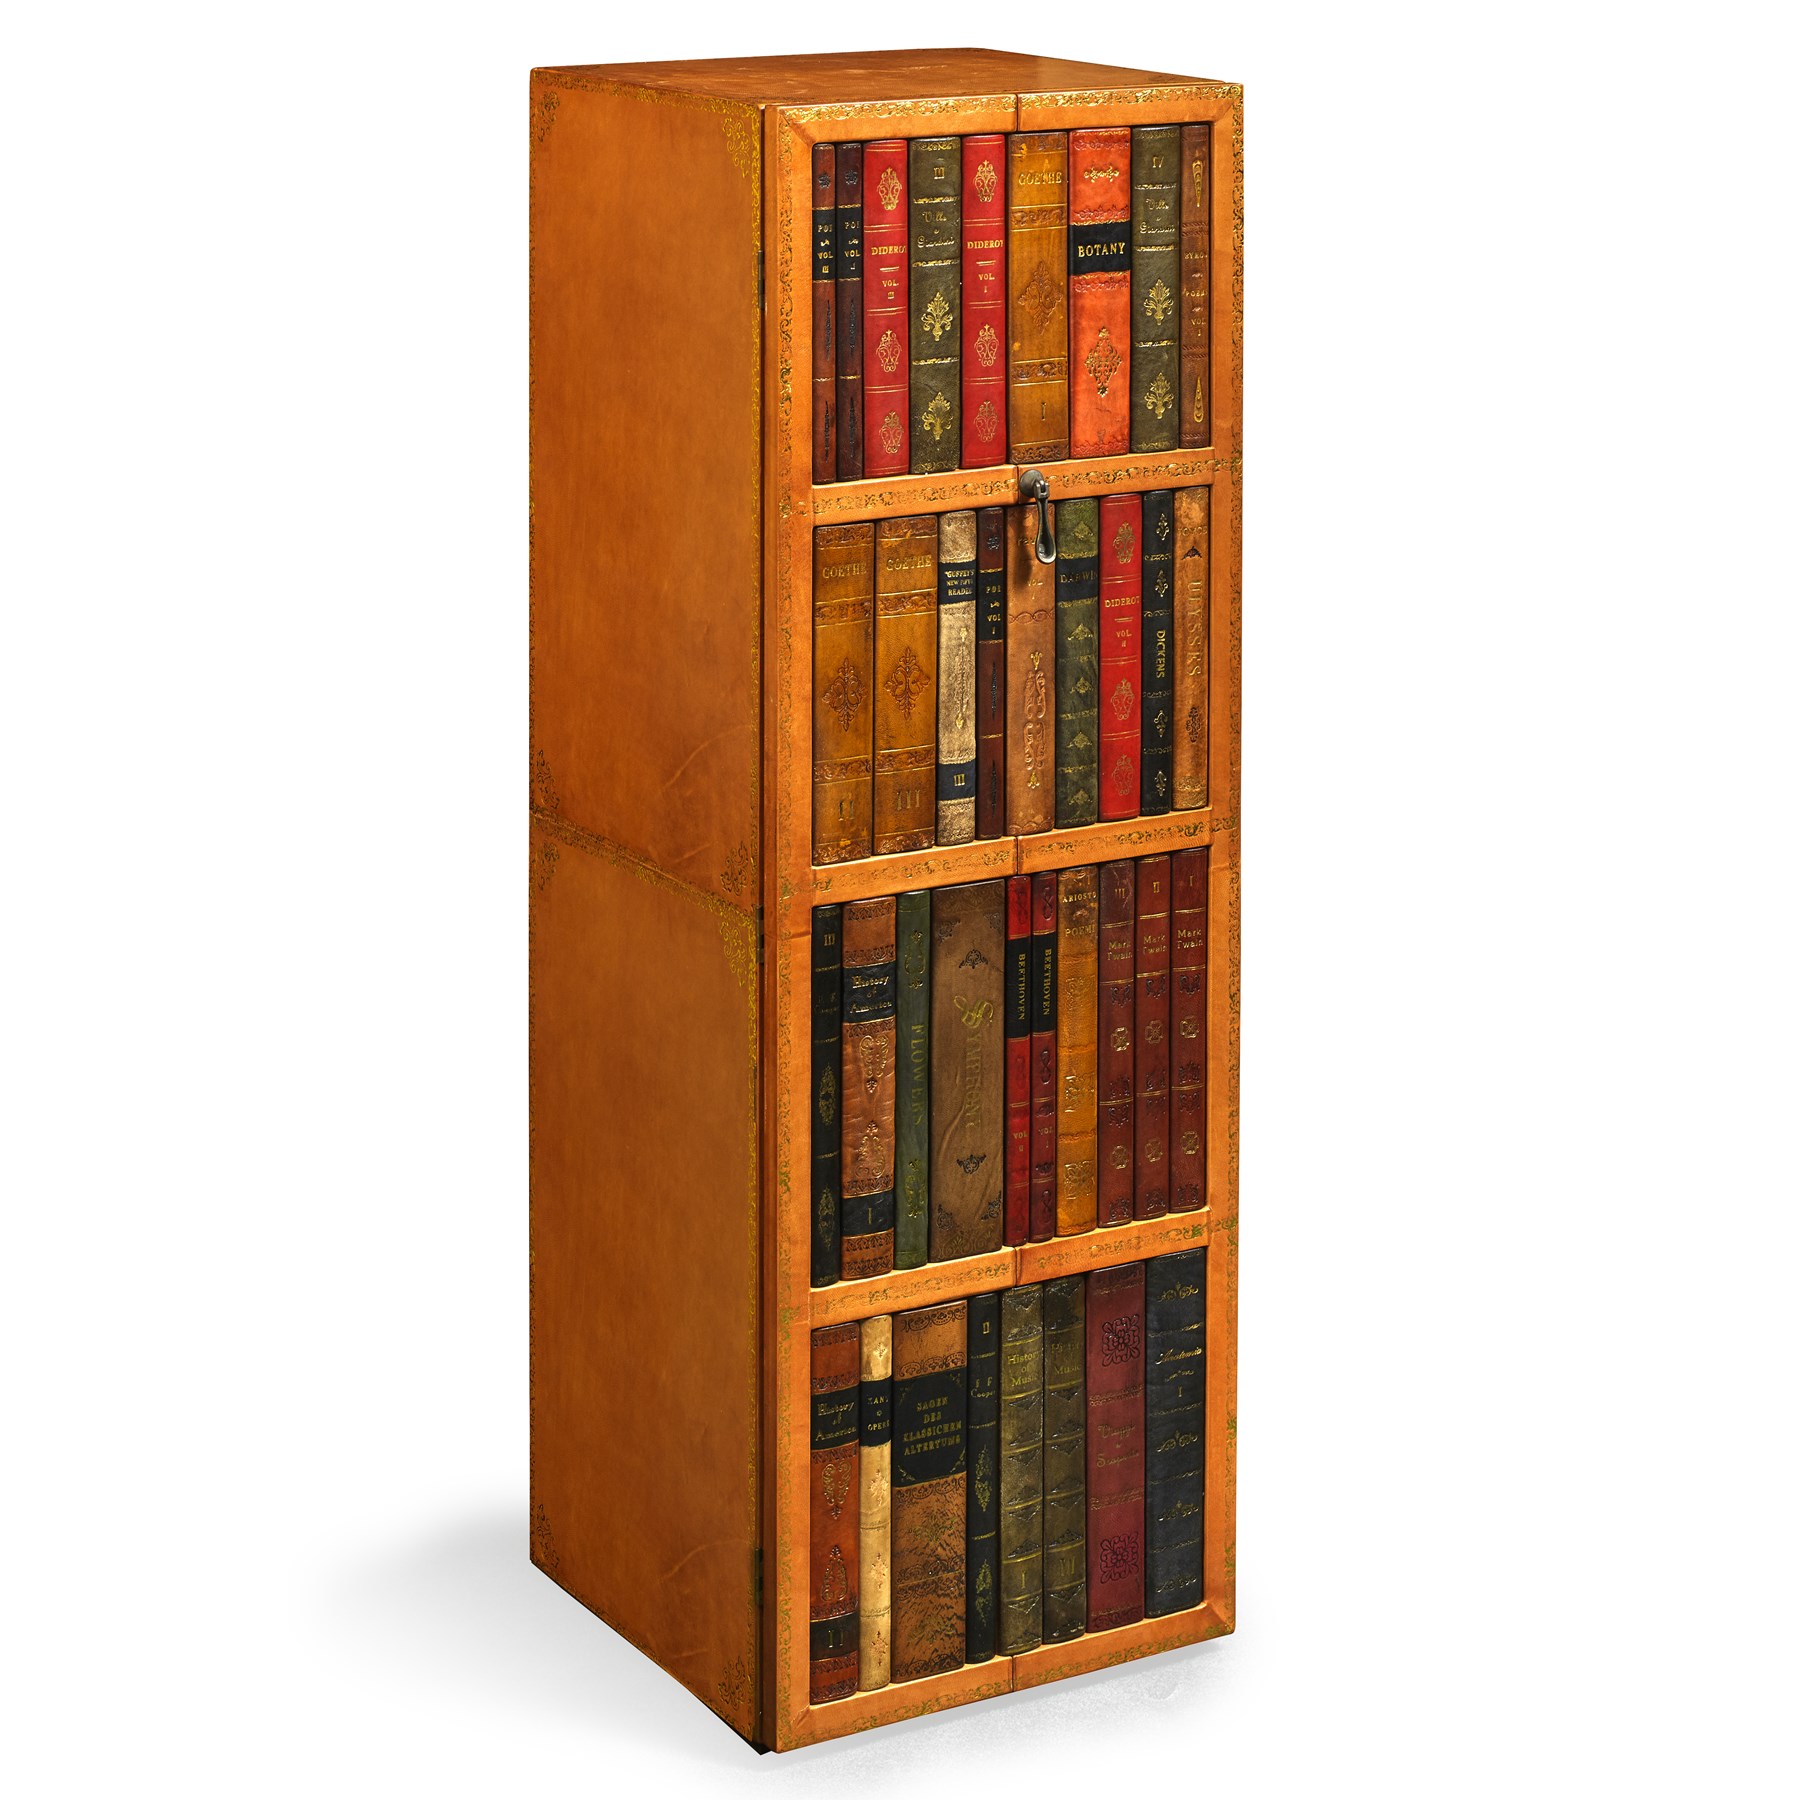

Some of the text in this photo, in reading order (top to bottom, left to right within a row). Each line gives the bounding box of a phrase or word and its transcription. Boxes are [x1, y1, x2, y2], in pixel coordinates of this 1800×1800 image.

[1018, 171, 1062, 186] GOETHE
[817, 250, 834, 260] VOL
[844, 249, 861, 258] VOL
[1077, 241, 1126, 258] BOTANY
[1041, 402, 1047, 421] I
[886, 554, 932, 571] GOETHE
[822, 561, 867, 580] GOETHE
[1156, 630, 1166, 679] DICKENS
[953, 773, 966, 787] III
[896, 788, 921, 811] III
[1153, 881, 1160, 894] II
[1061, 892, 1097, 904] ARIOSTO
[823, 932, 836, 947] III
[1177, 927, 1202, 938] Mark
[1108, 940, 1131, 951] Mark
[852, 975, 890, 989] History
[1018, 953, 1026, 1021] BEETHOVEN
[1042, 948, 1052, 1016] BEETHOVEN
[911, 1024, 928, 1126] FLOWERS
[868, 1207, 873, 1225] I
[817, 1401, 855, 1416] History
[916, 1396, 949, 1411] SAGEN
[923, 1412, 942, 1423] DES
[815, 1426, 857, 1442] America
[903, 1420, 962, 1442] KLASSICHEN
[903, 1434, 961, 1456] ALTERTUMS
